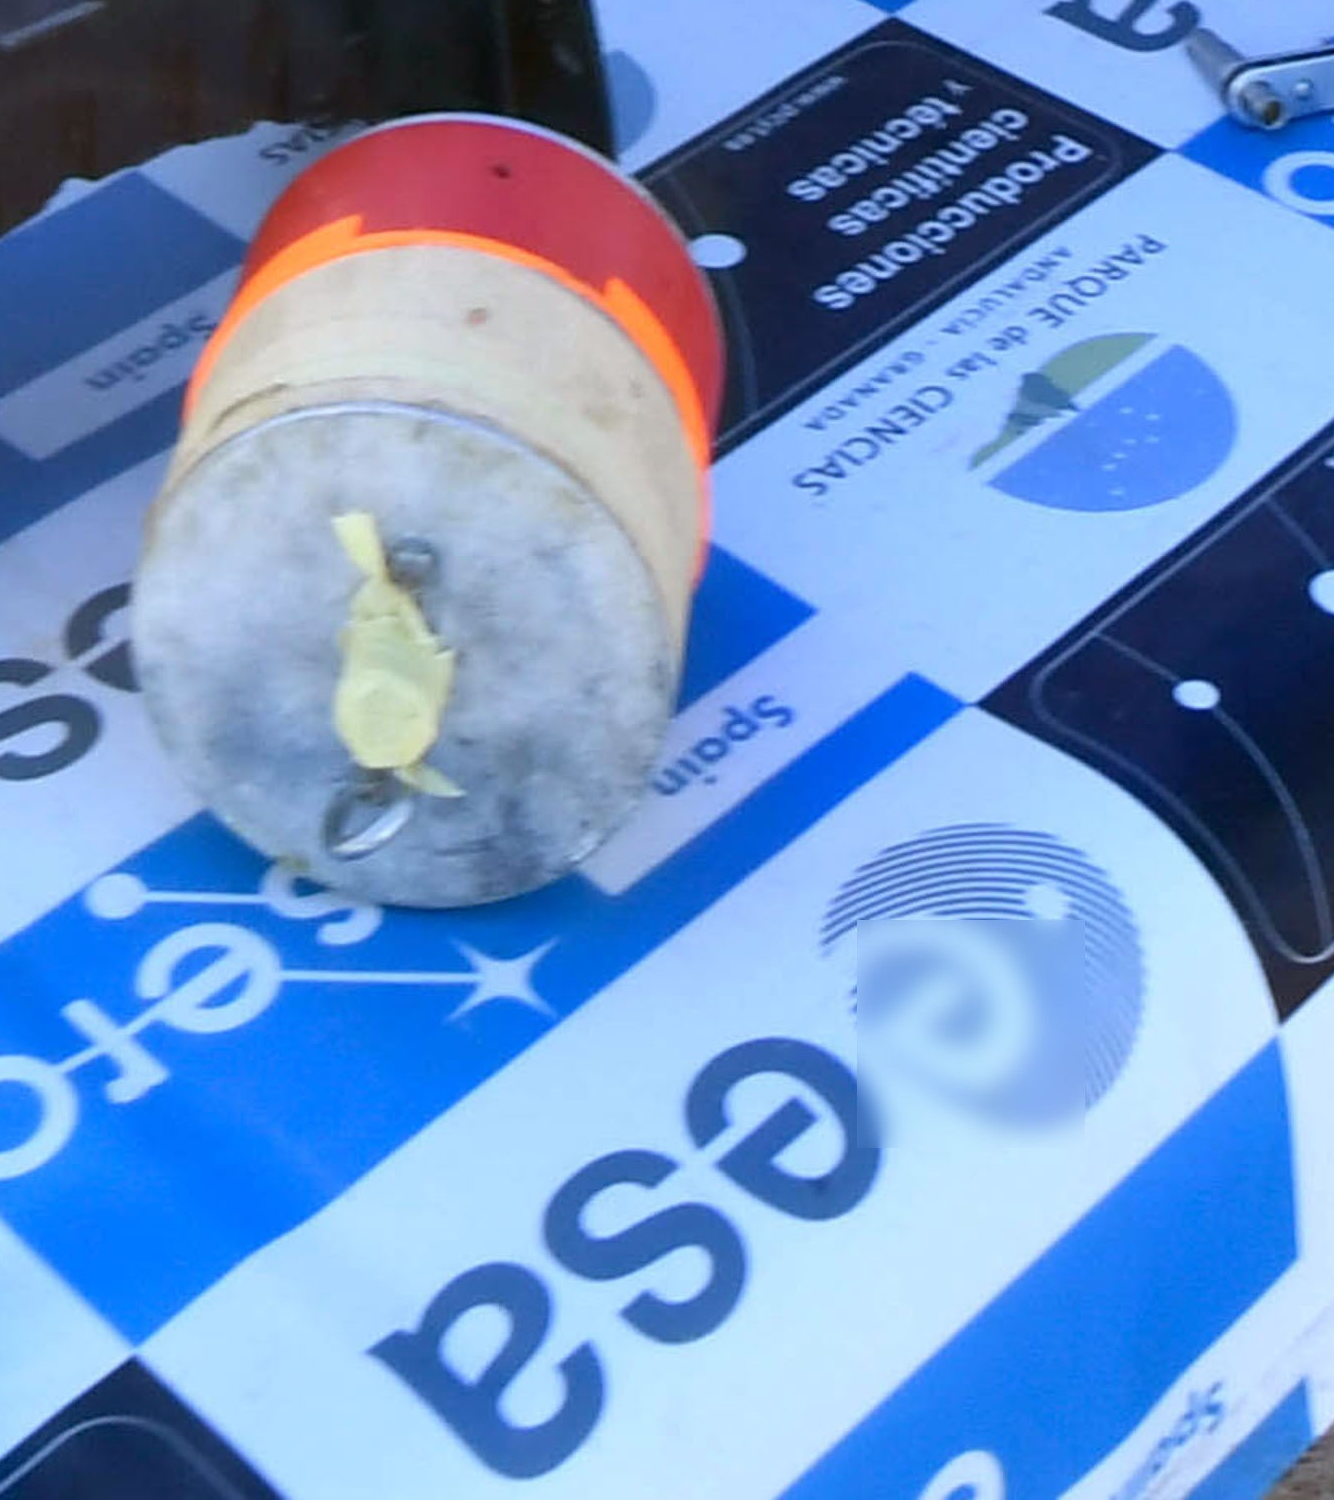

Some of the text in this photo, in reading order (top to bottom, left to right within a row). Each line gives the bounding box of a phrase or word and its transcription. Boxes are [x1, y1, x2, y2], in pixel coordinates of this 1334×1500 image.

[786, 96, 965, 202] técnicas
[812, 134, 1094, 311] Producciones
[87, 313, 216, 393] Spain
[792, 232, 1170, 498] PARQUE de las CIENCIAS
[650, 694, 796, 799] Spain
[366, 1036, 884, 1481] esa
